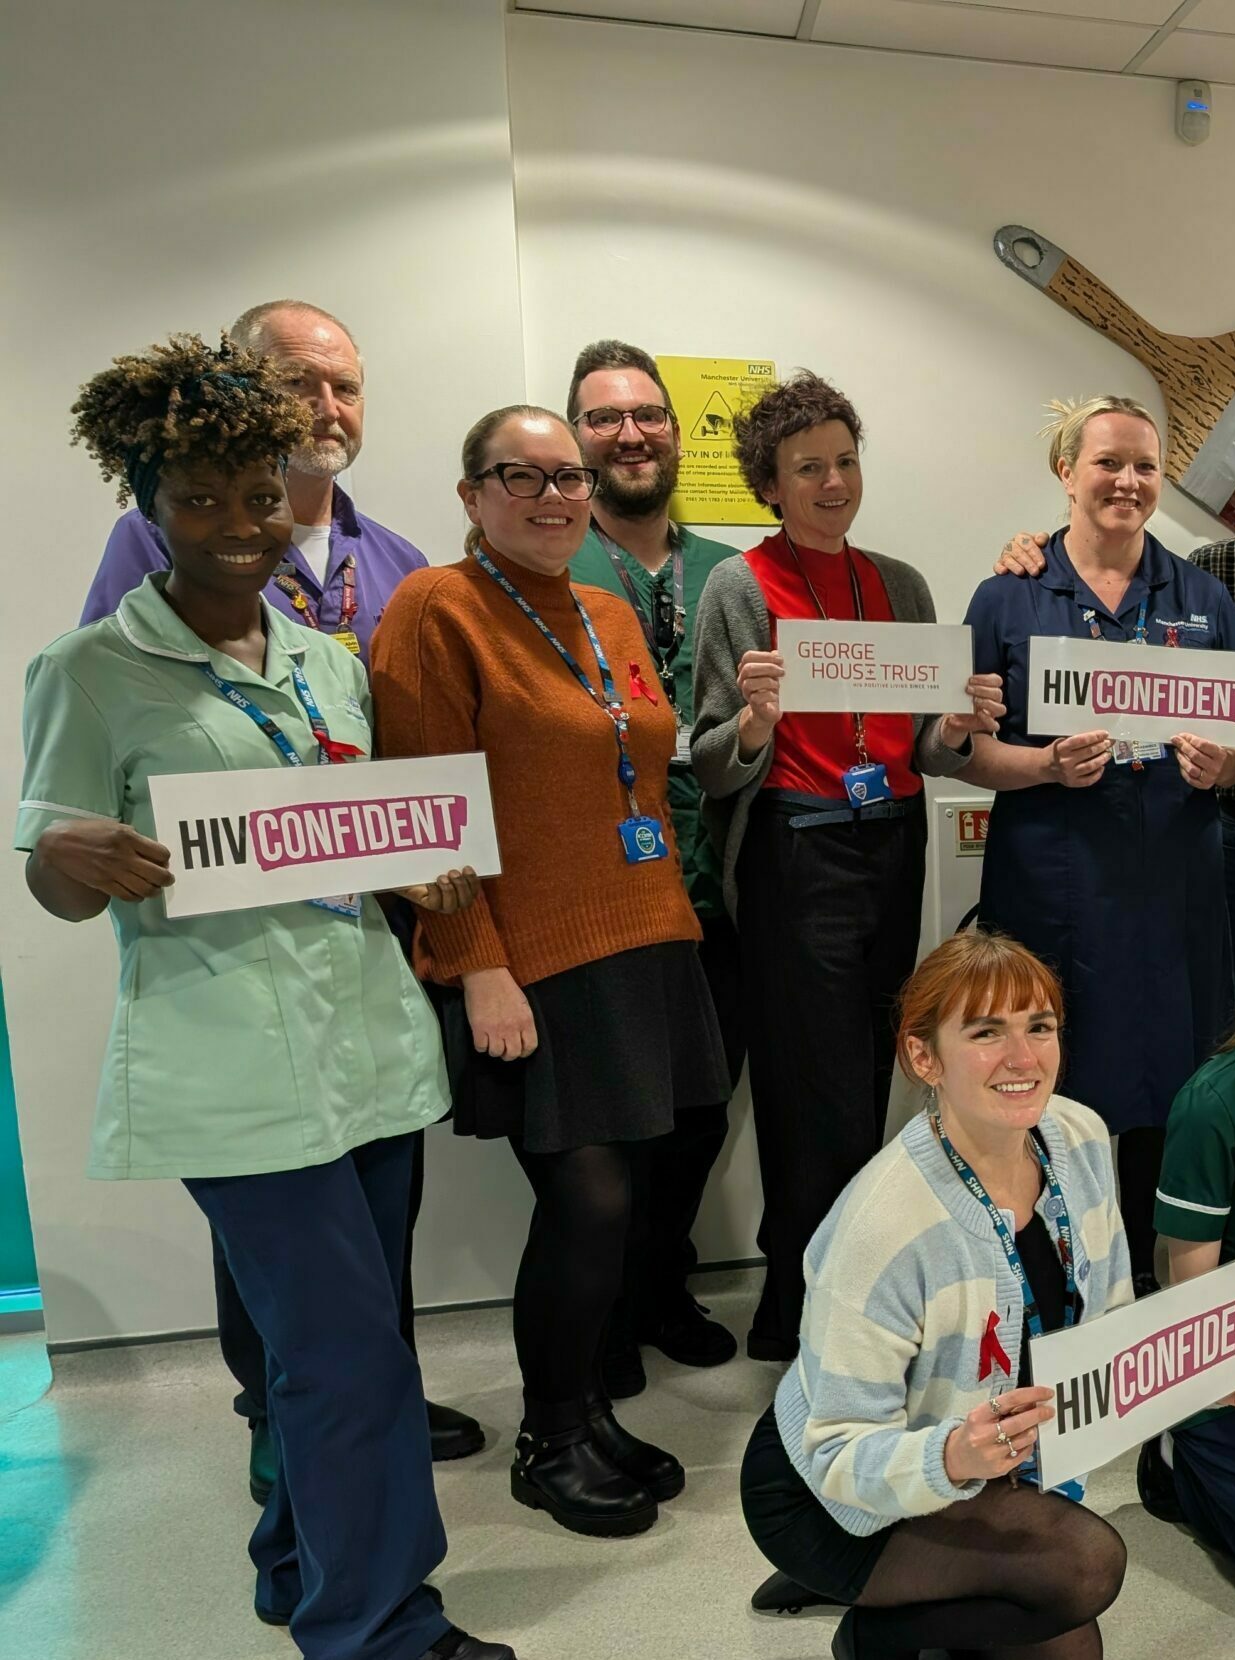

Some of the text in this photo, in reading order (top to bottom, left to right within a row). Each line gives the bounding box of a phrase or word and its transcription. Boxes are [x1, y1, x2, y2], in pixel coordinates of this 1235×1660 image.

[700, 374, 739, 382] Manchester
[749, 365, 771, 375] NHS
[700, 450, 710, 458] IN
[1190, 613, 1208, 624] NHS
[797, 641, 876, 660] GEORGE
[880, 664, 940, 682] TRUST
[1043, 669, 1091, 706] HIV
[226, 689, 250, 709] NHS
[287, 751, 302, 767] NH
[178, 796, 457, 870] HIV CONFIDENT
[1044, 1164, 1058, 1187] NHS
[937, 1118, 946, 1139] NHS
[966, 1176, 986, 1199] NHS
[987, 1203, 1003, 1227] NHS
[1002, 1232, 1015, 1256] NHS
[1011, 1262, 1025, 1285] NHS
[1055, 1362, 1112, 1436] HIV
